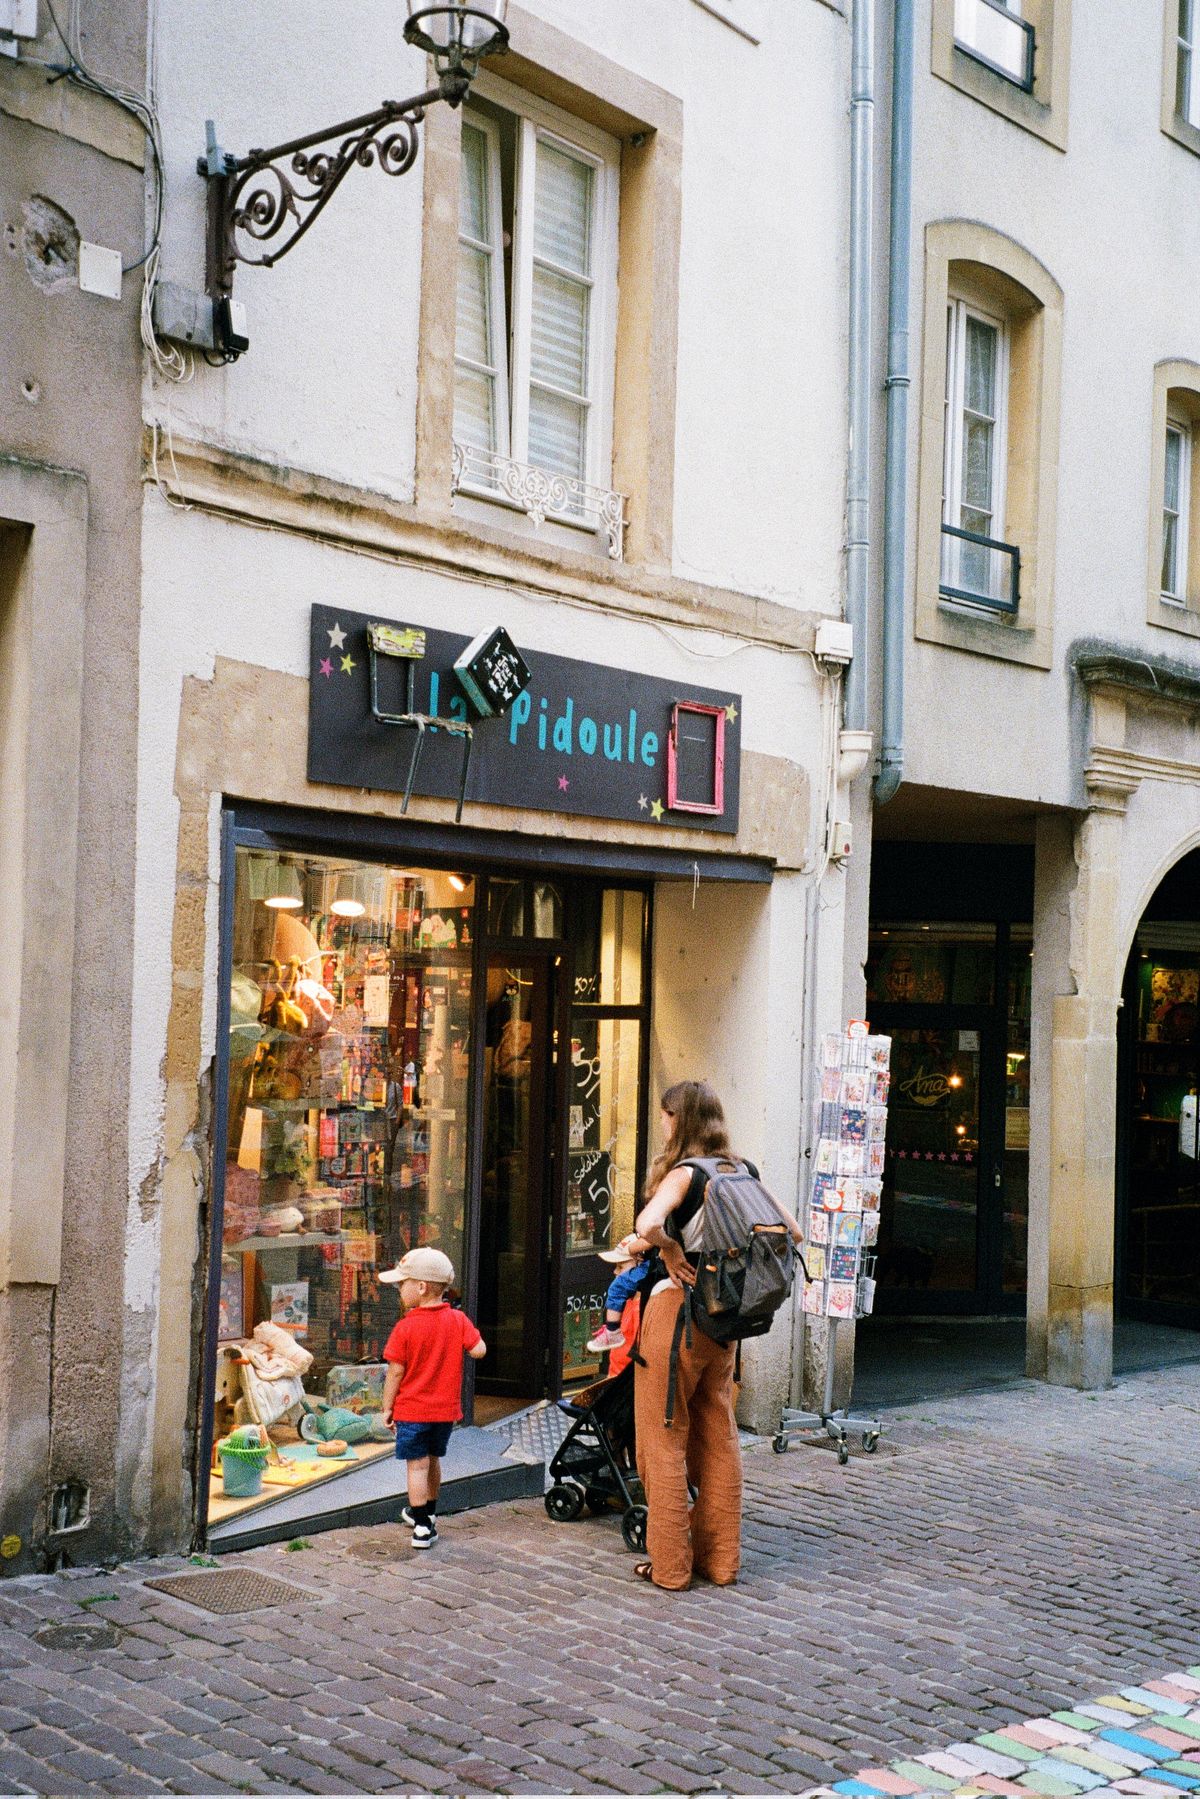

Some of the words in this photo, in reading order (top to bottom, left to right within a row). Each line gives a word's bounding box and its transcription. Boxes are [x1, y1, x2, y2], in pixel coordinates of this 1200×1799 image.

[509, 689, 659, 767] Pidoule
[574, 975, 597, 996] 50%
[589, 1291, 607, 1311] 50
